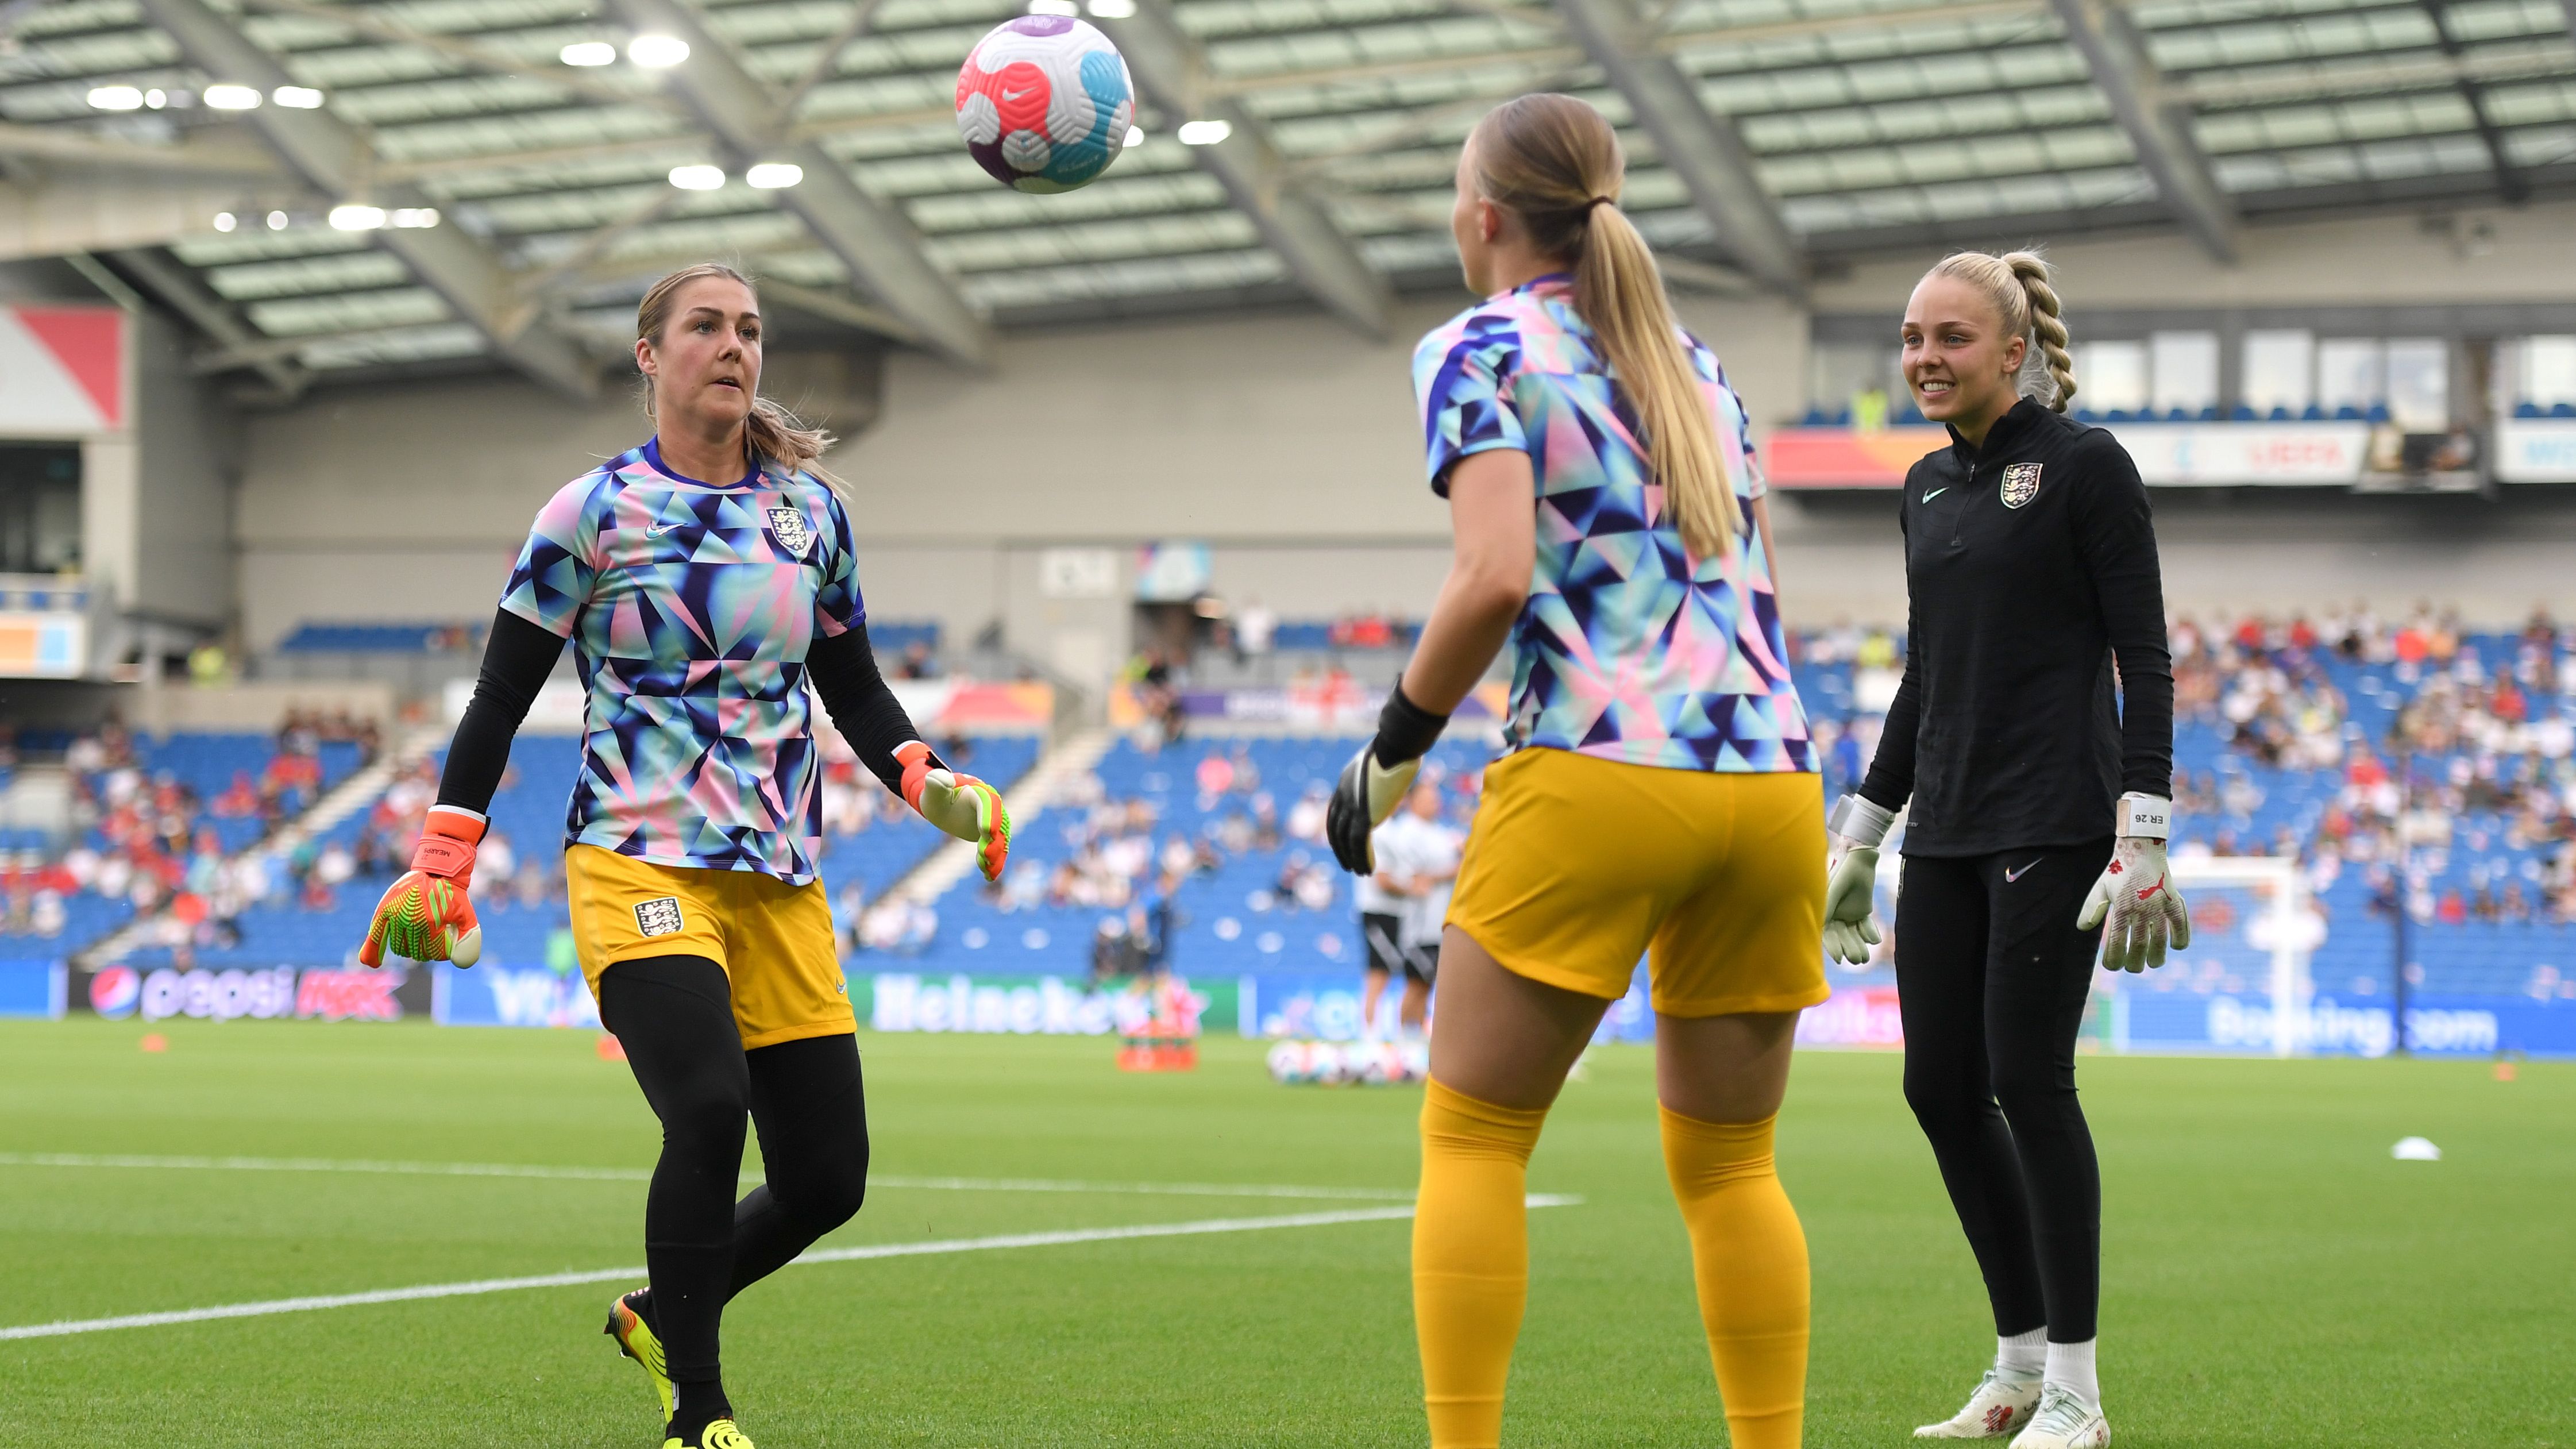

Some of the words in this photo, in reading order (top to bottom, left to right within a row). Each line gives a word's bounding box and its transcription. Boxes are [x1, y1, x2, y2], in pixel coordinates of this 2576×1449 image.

[2135, 814, 2147, 823] 26
[2150, 815, 2164, 824] ER
[424, 847, 450, 857] MEARPS
[141, 965, 295, 1023] pepsi
